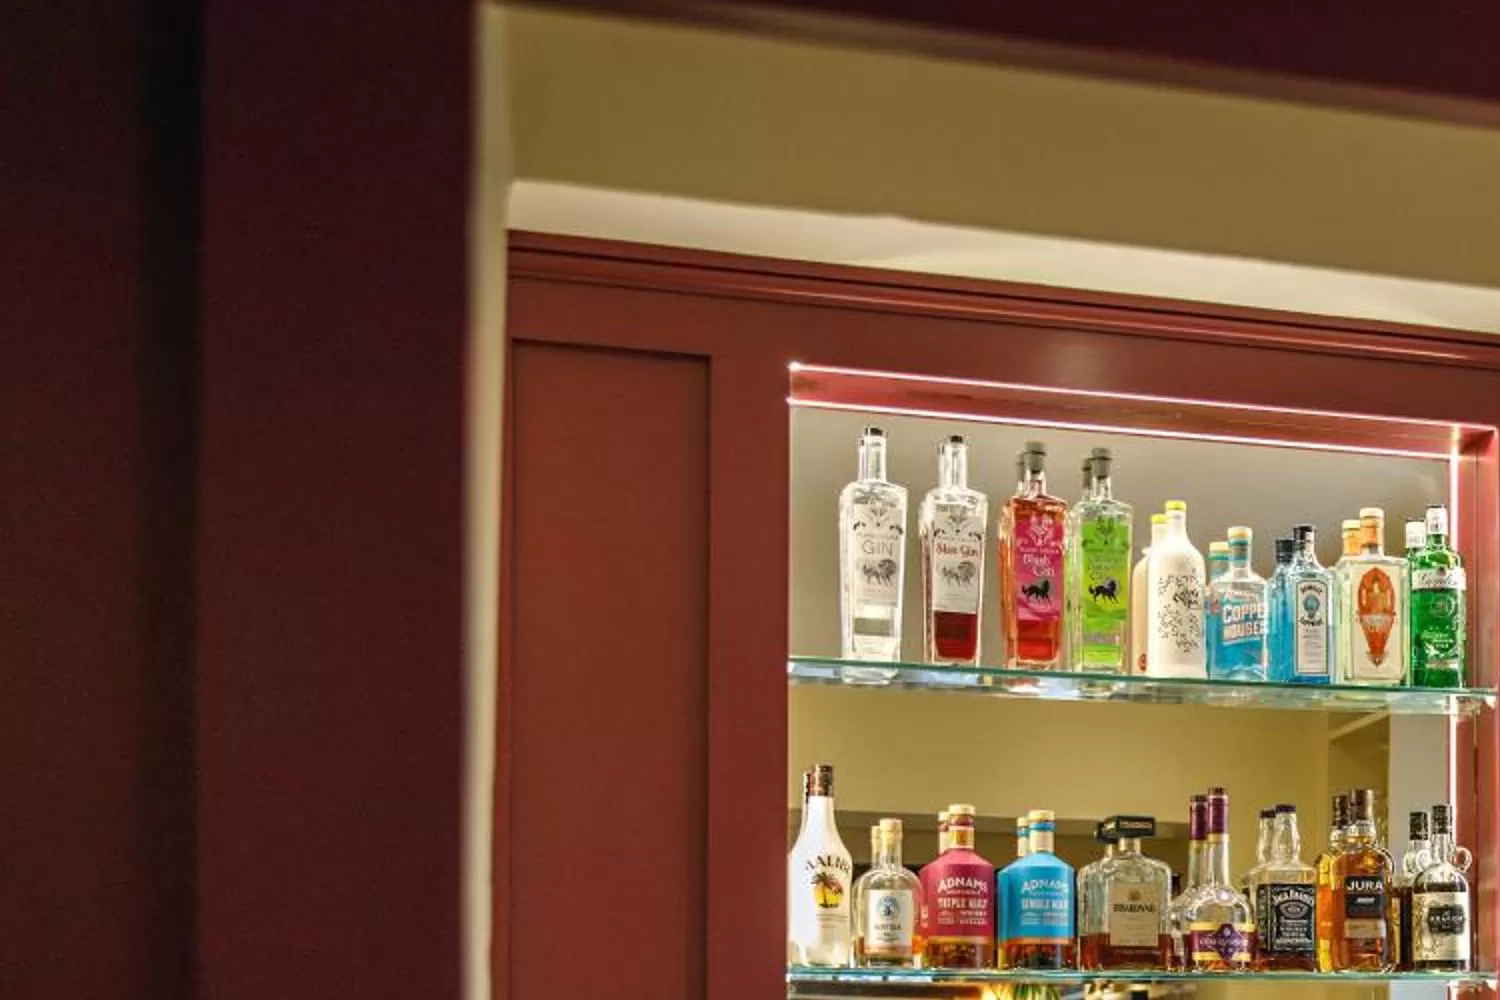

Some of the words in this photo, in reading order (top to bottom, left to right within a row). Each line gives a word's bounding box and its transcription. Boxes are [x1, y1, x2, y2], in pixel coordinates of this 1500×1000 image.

[862, 539, 894, 556] GIN
[937, 876, 989, 893] ADNAMS
[1021, 879, 1069, 894] ADNAMS
[1346, 880, 1384, 892] JURA
